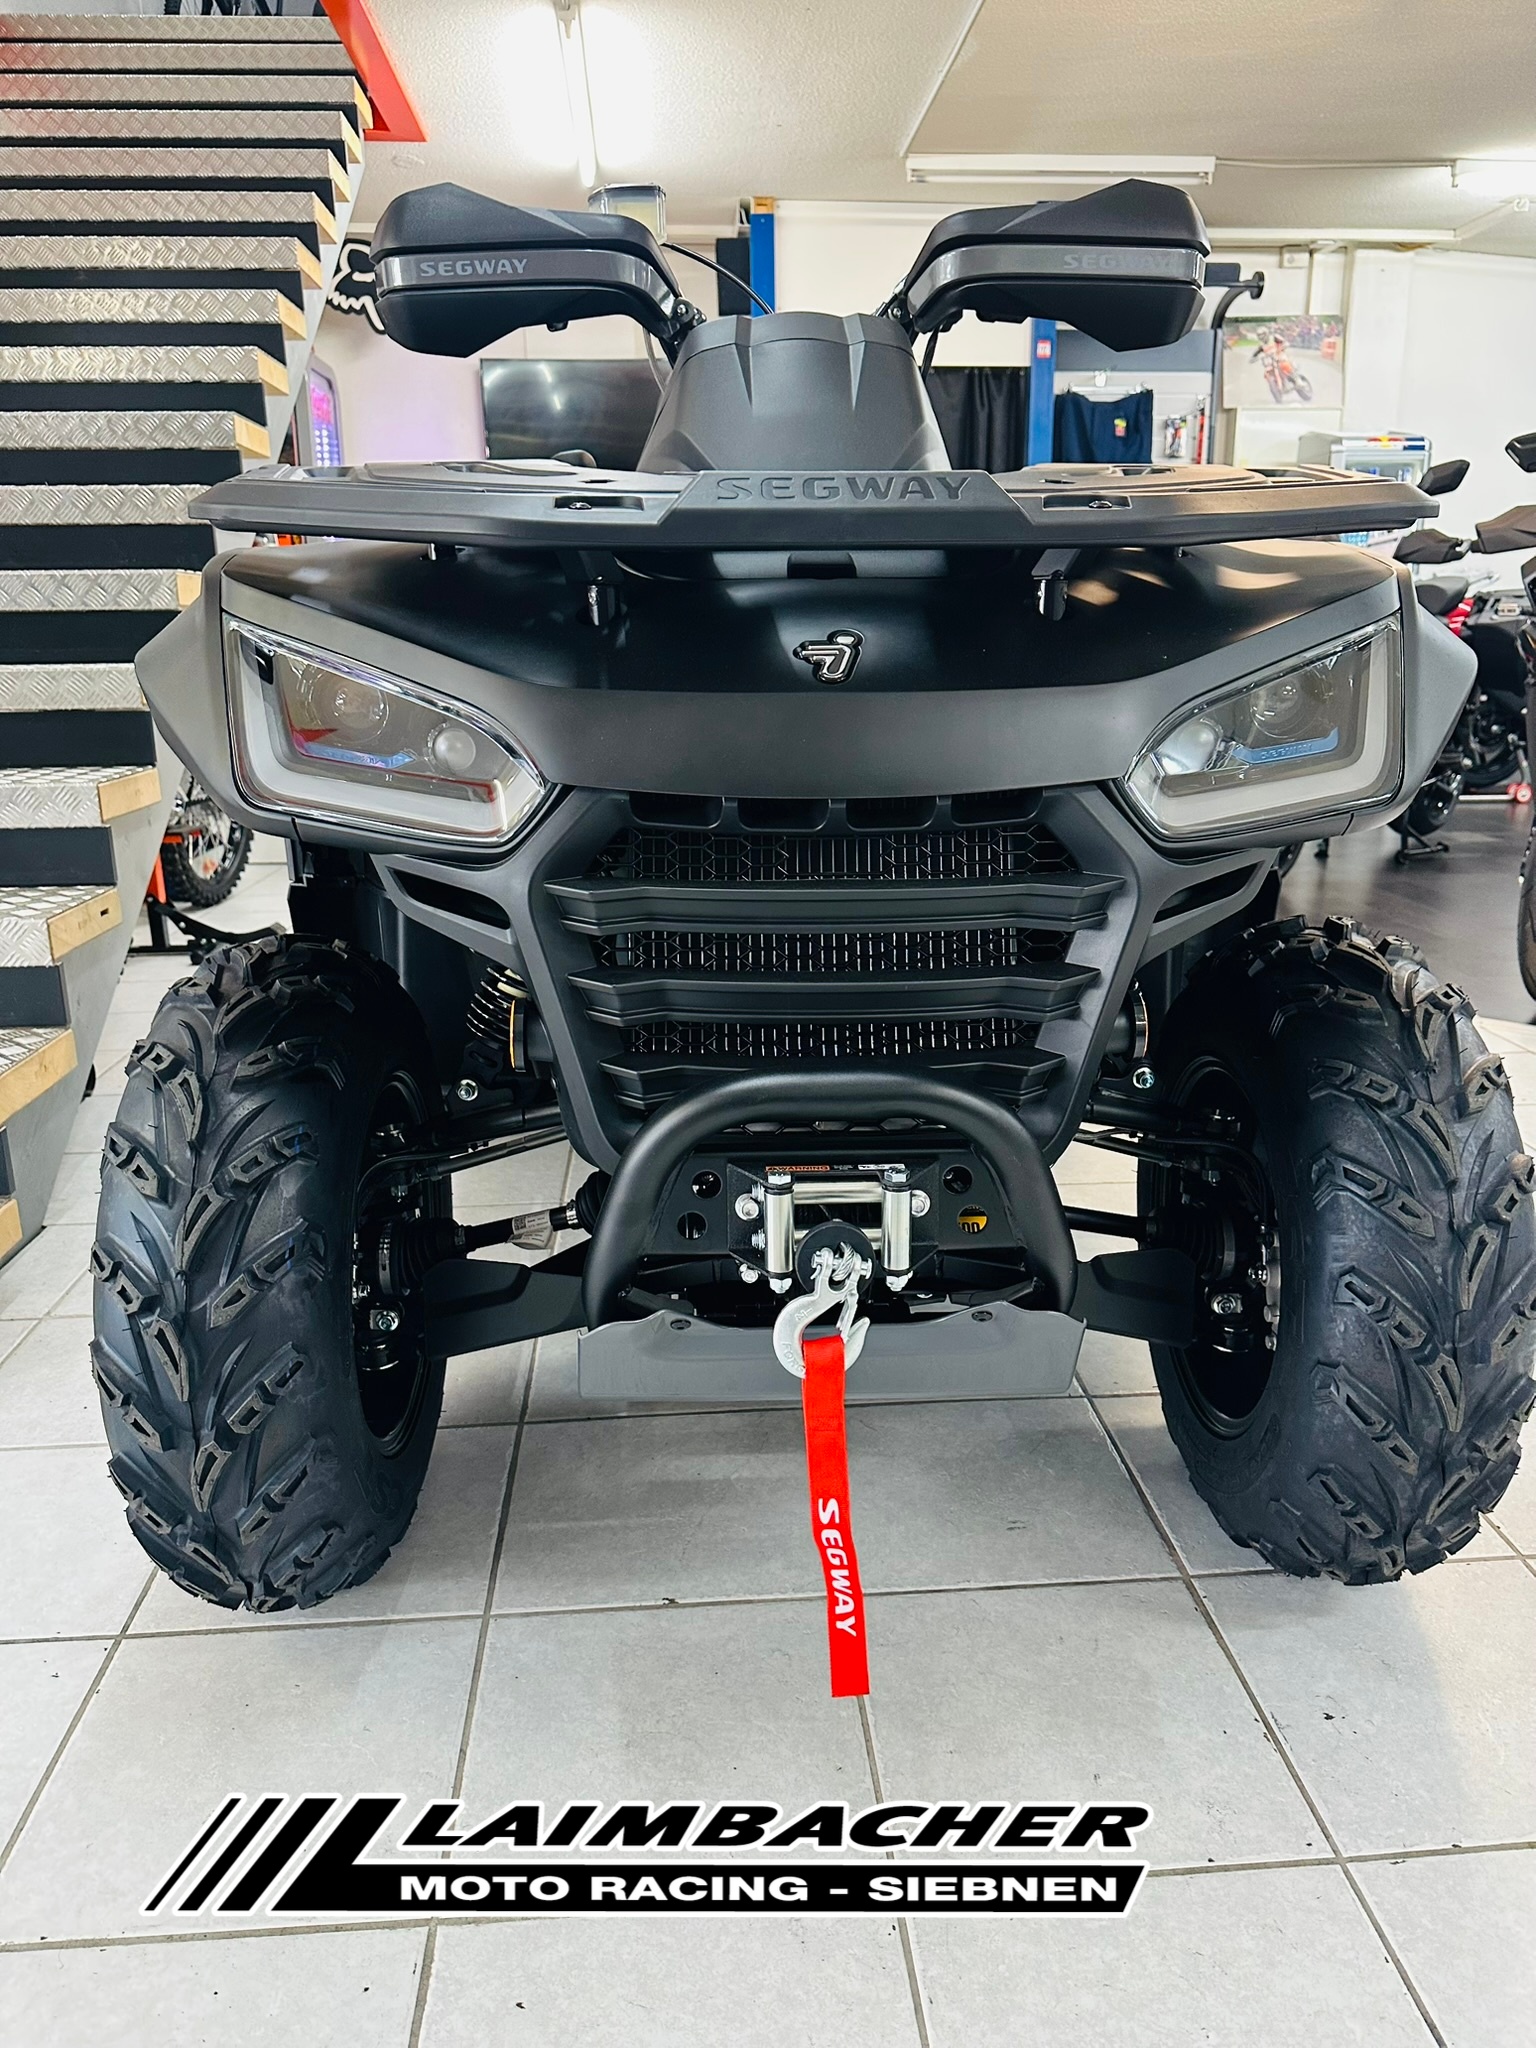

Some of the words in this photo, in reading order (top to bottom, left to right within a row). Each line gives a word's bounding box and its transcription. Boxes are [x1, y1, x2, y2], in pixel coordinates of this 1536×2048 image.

[419, 258, 528, 277] SEGWAY
[1063, 253, 1173, 271] SEGWAY
[716, 476, 971, 501] SEGWAY
[818, 1497, 857, 1637] SEGWAY
